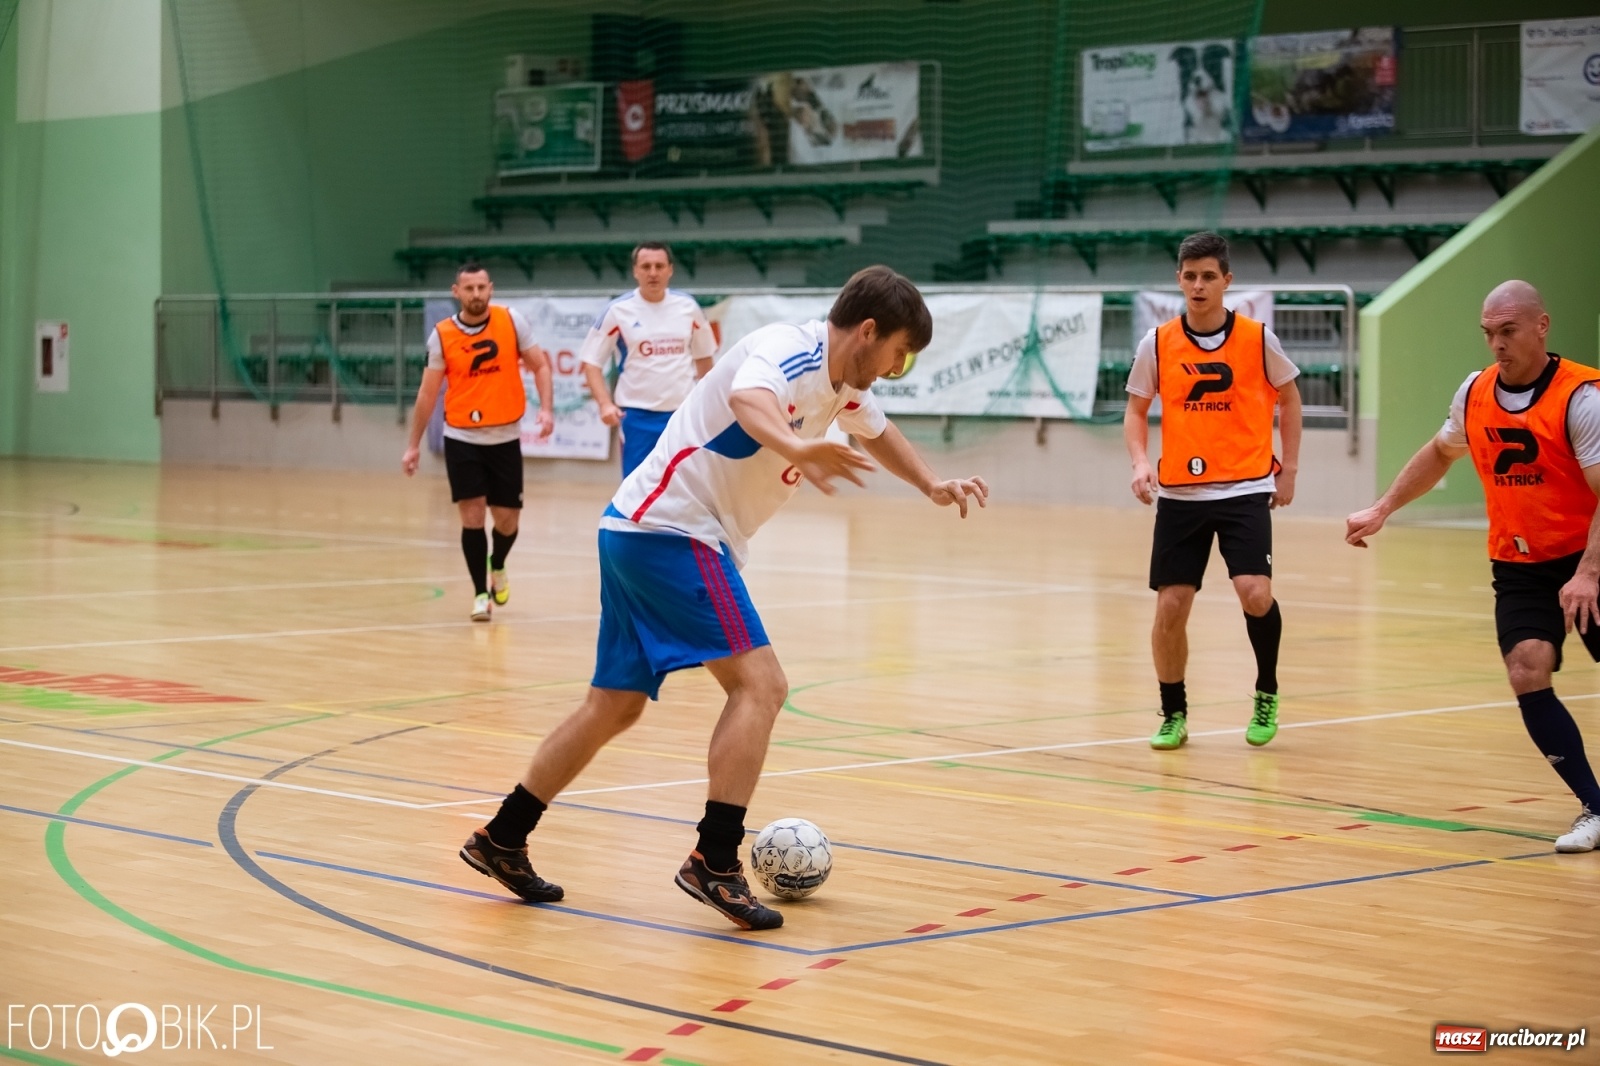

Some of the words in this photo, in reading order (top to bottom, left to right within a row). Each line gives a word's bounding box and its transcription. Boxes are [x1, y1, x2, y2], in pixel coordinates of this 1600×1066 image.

[928, 361, 964, 393] JEST
[967, 352, 985, 373] W
[1183, 401, 1232, 412] PATRICK
[1191, 457, 1204, 475] 9
[1494, 473, 1545, 486] PATRICK
